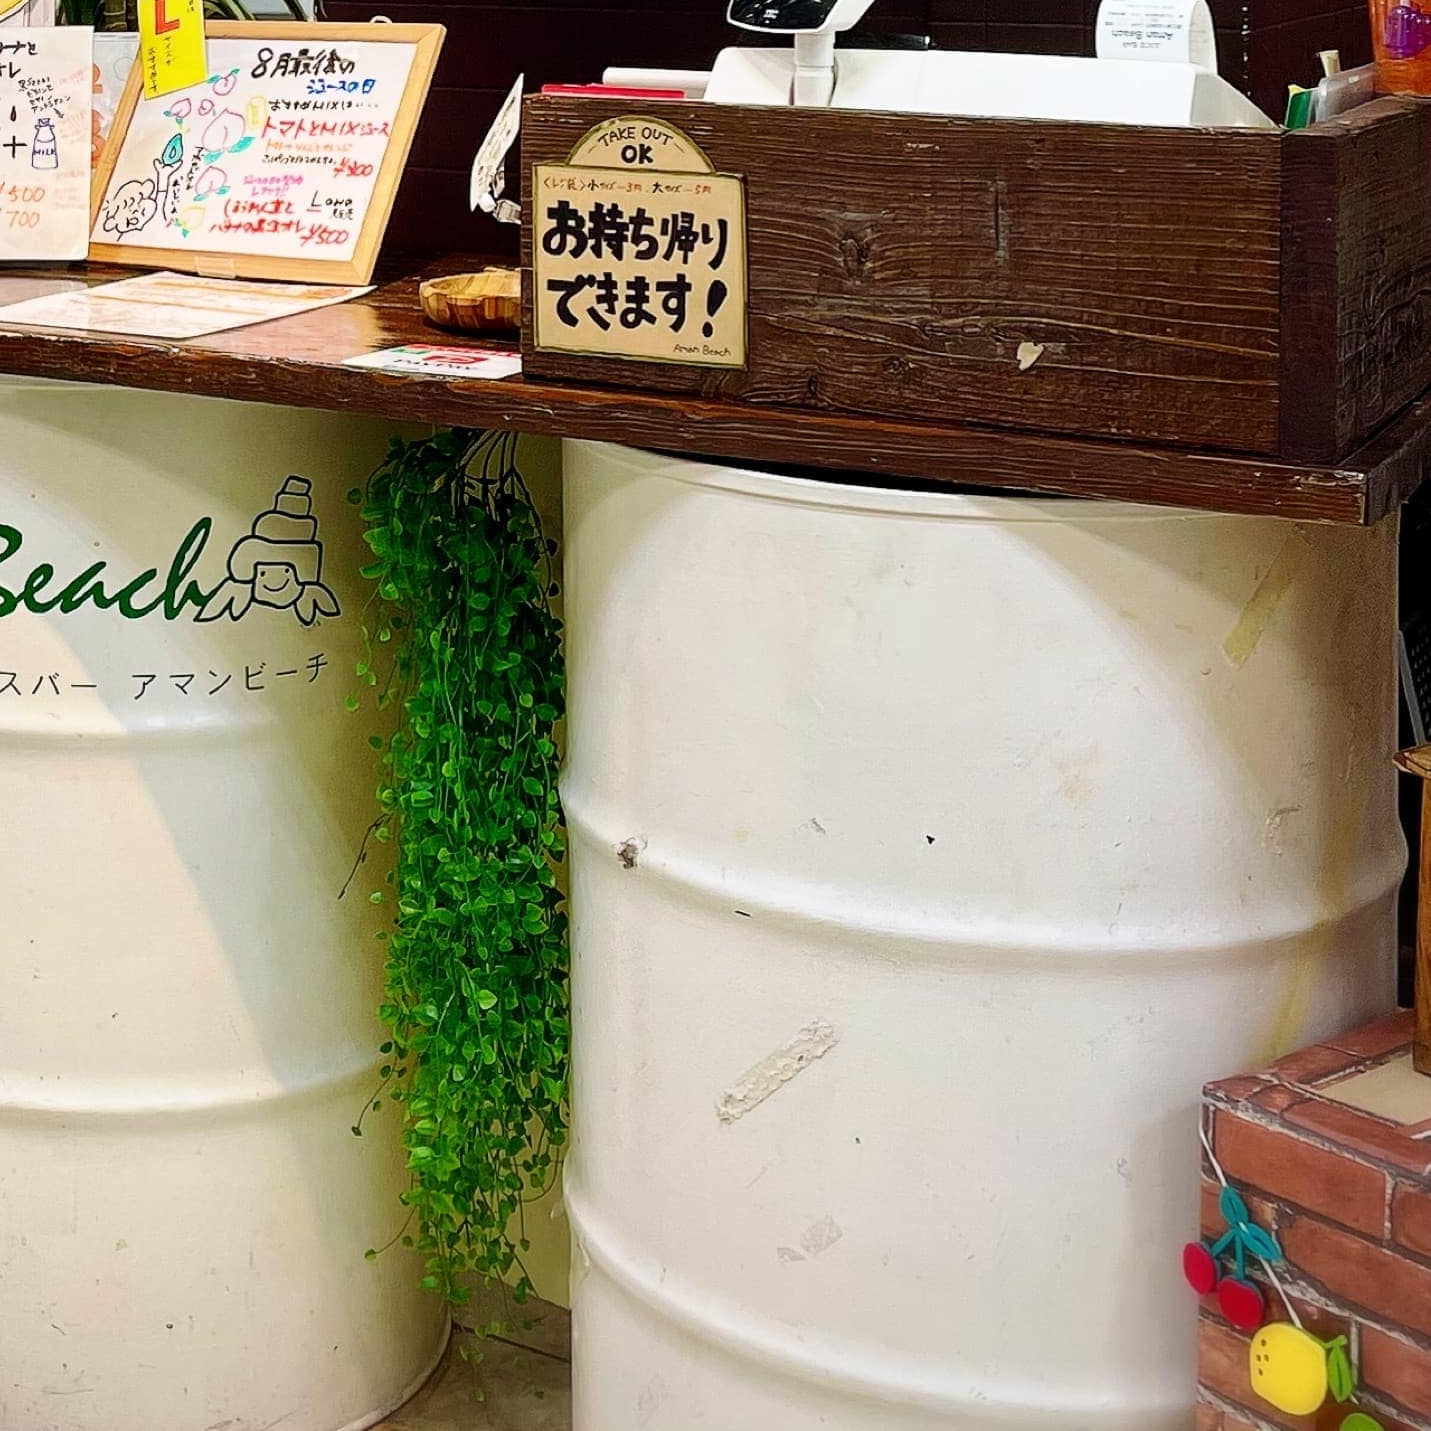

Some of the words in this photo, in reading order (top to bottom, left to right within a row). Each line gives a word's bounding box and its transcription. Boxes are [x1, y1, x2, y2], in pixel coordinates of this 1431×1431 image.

[598, 126, 636, 148] TAKE
[642, 126, 675, 147] OUT
[620, 144, 654, 164] OK
[542, 200, 728, 270] お持ち帰り
[546, 272, 728, 338] できます!
[673, 342, 700, 355] Aman
[702, 345, 732, 358] Beach
[132, 652, 329, 700] アマンビーチ
